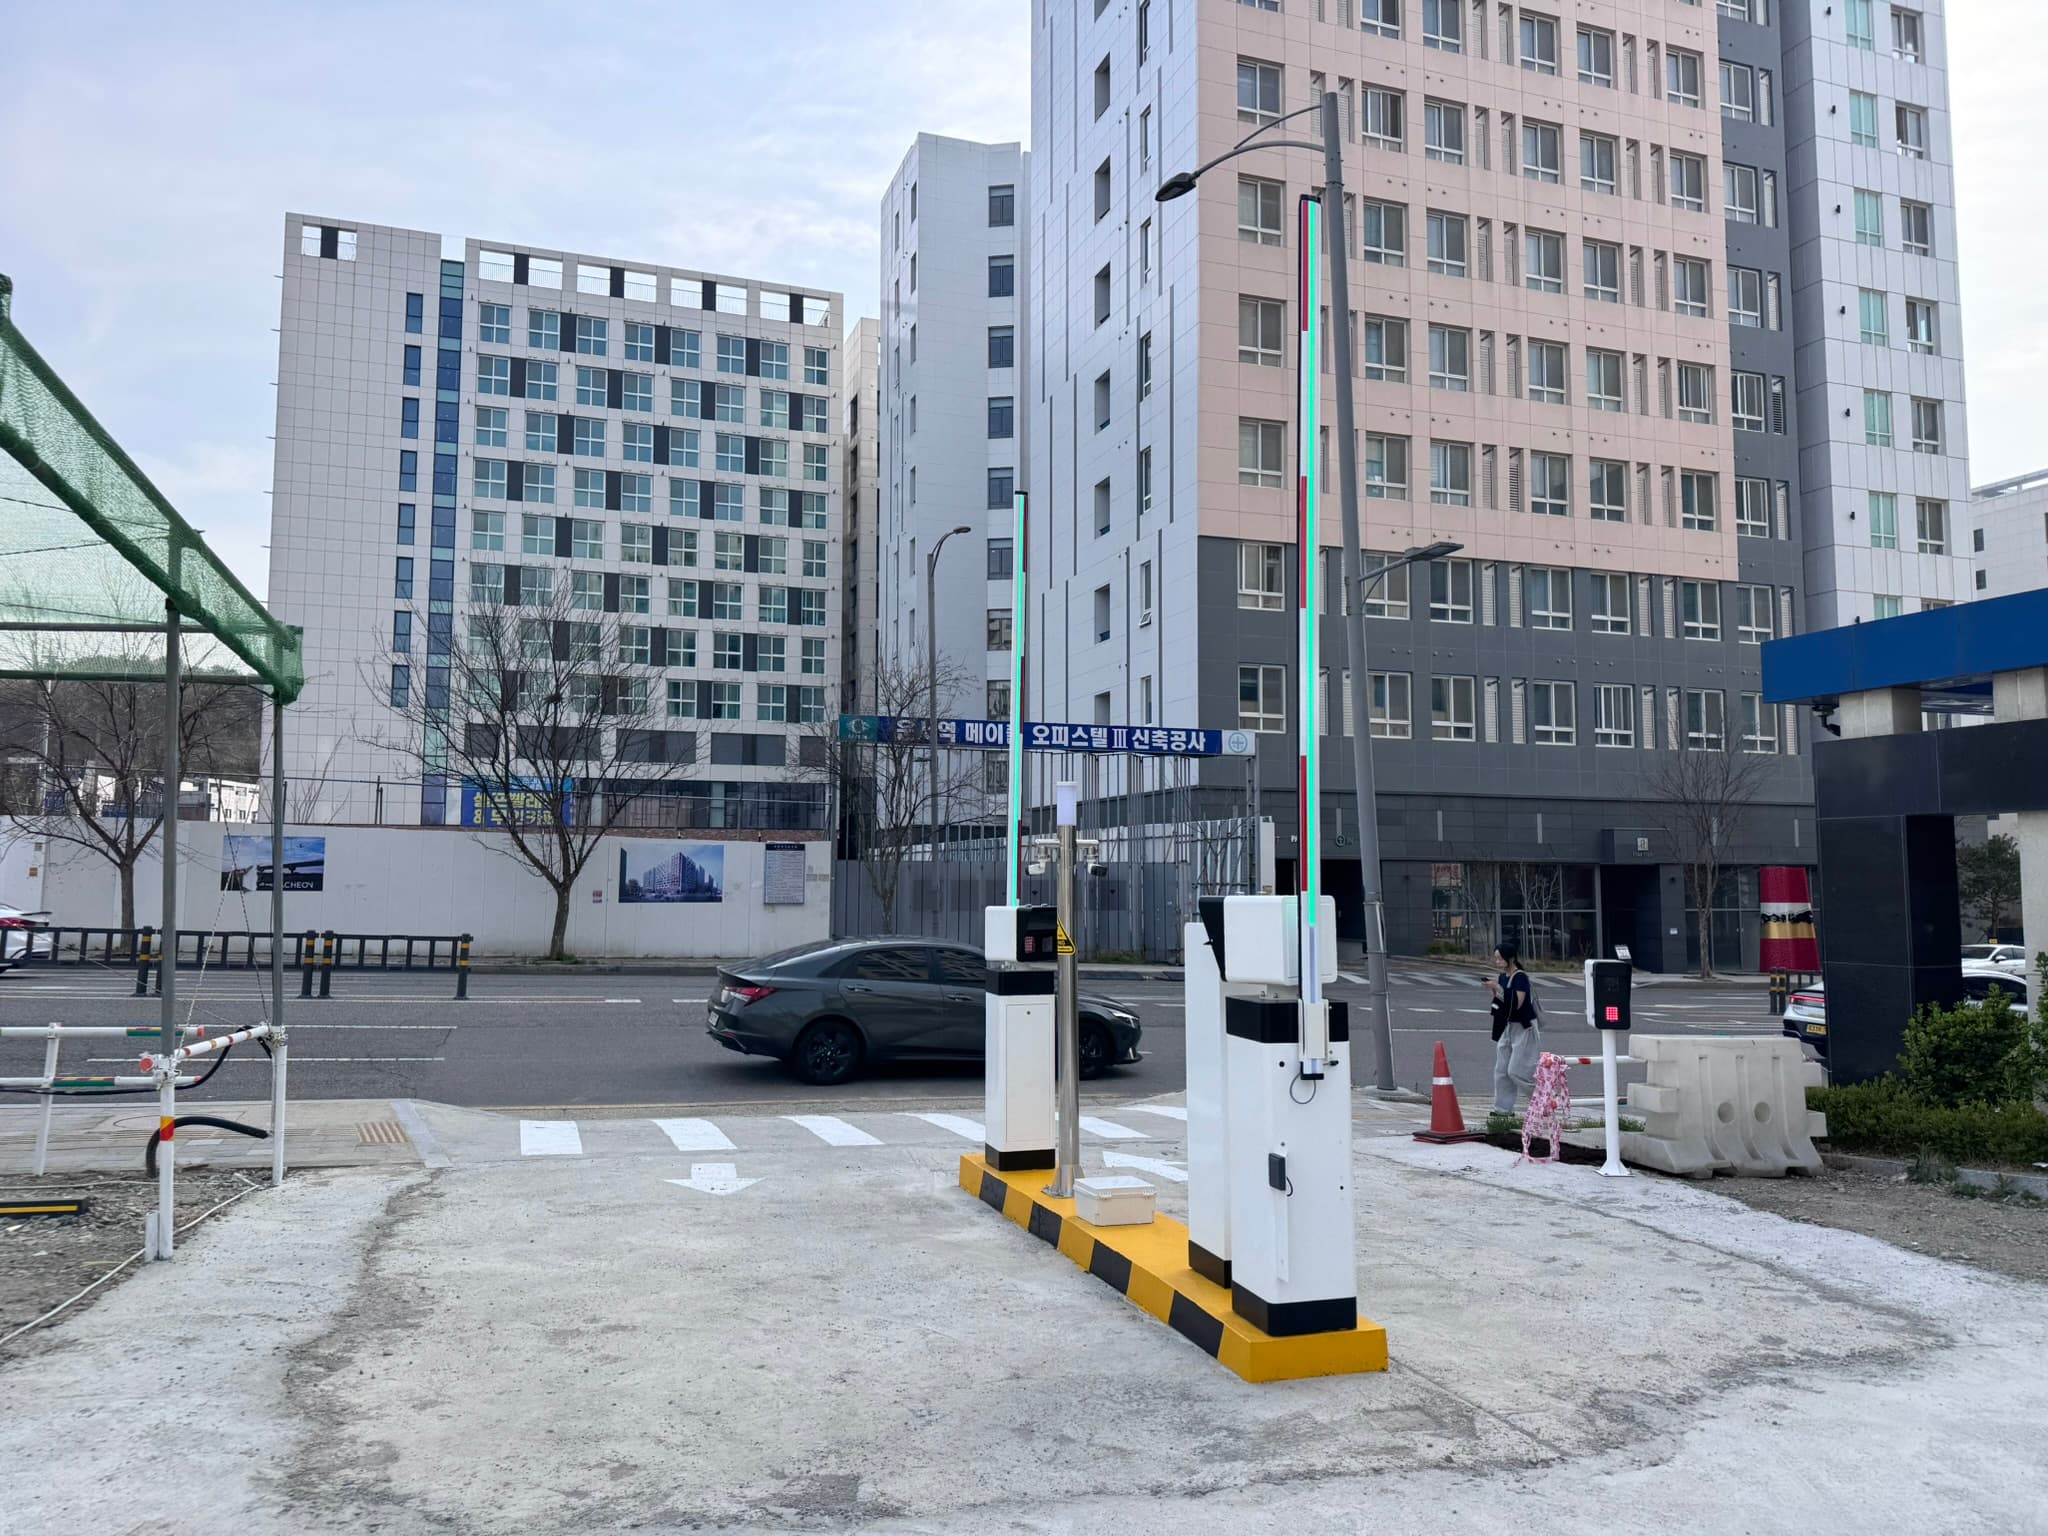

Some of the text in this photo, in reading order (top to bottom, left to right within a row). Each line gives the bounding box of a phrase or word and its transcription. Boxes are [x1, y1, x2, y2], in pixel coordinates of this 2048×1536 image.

[965, 722, 1011, 745] 메이
[473, 792, 552, 808] 셀프빨래
[281, 881, 314, 889] CHEON
